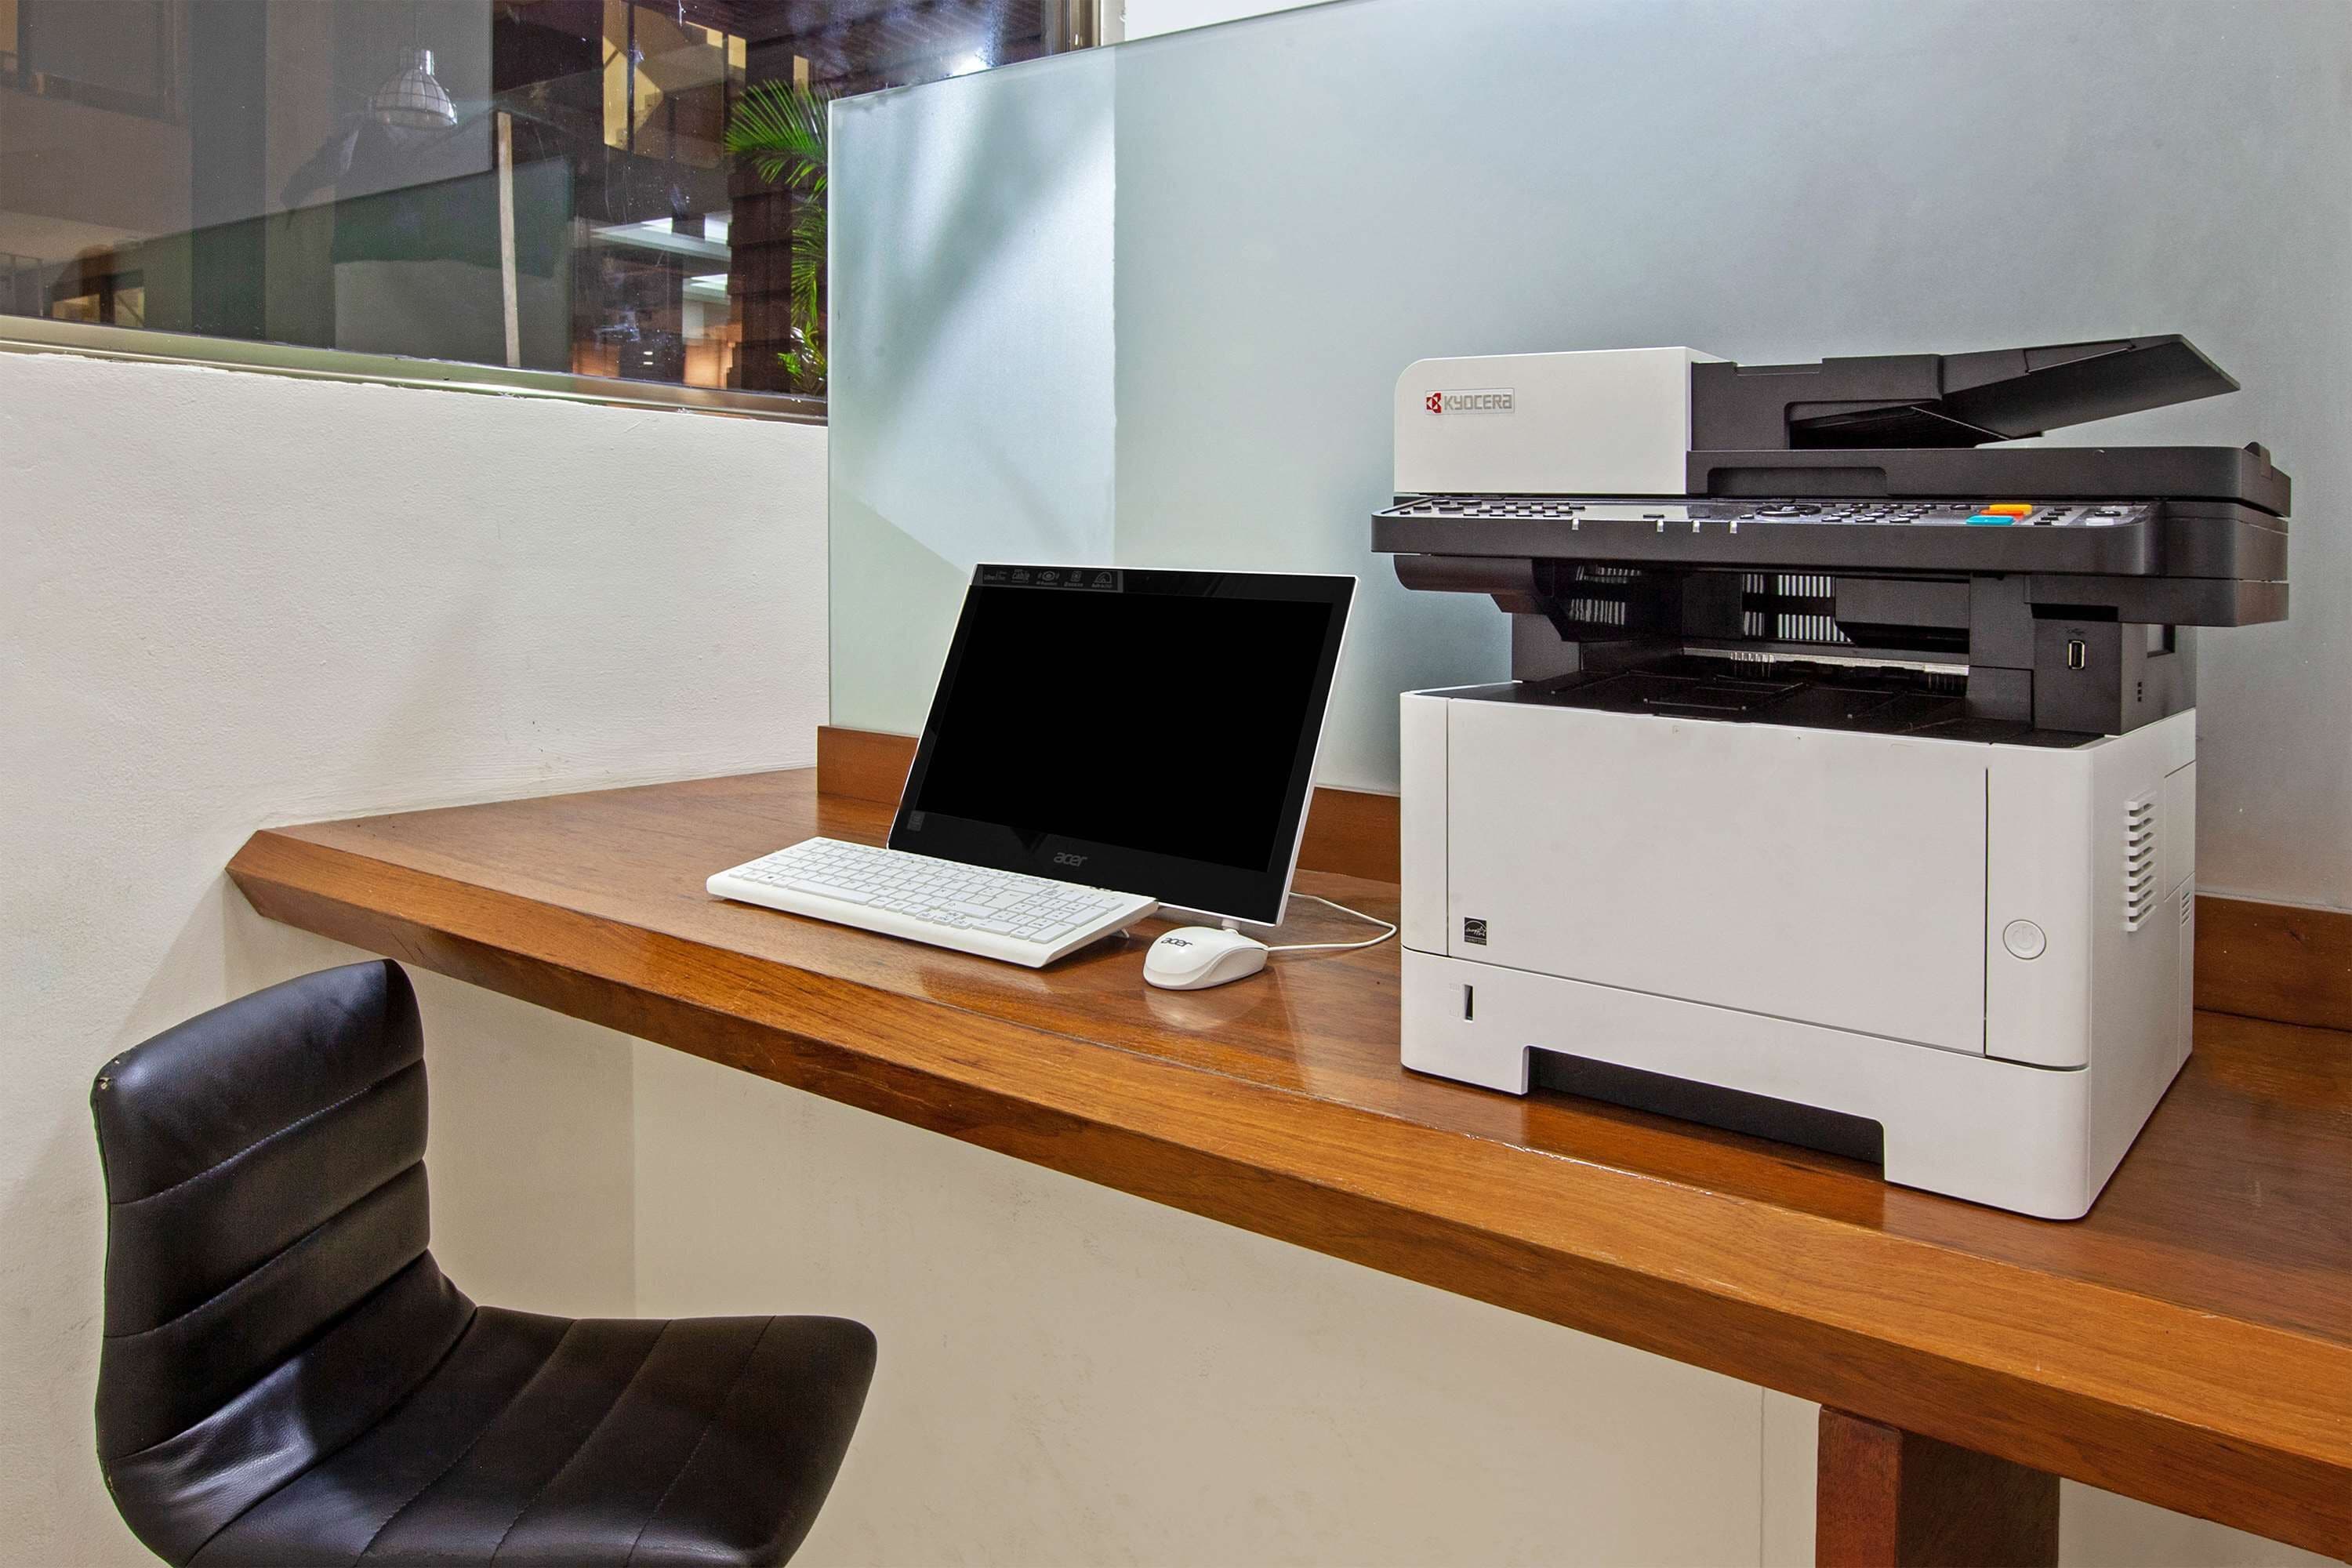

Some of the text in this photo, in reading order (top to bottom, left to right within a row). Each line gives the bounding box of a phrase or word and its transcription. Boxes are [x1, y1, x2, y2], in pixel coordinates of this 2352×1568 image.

[1444, 394, 1513, 410] KYOCERA
[1053, 852, 1088, 867] acer
[1160, 937, 1193, 947] acer
